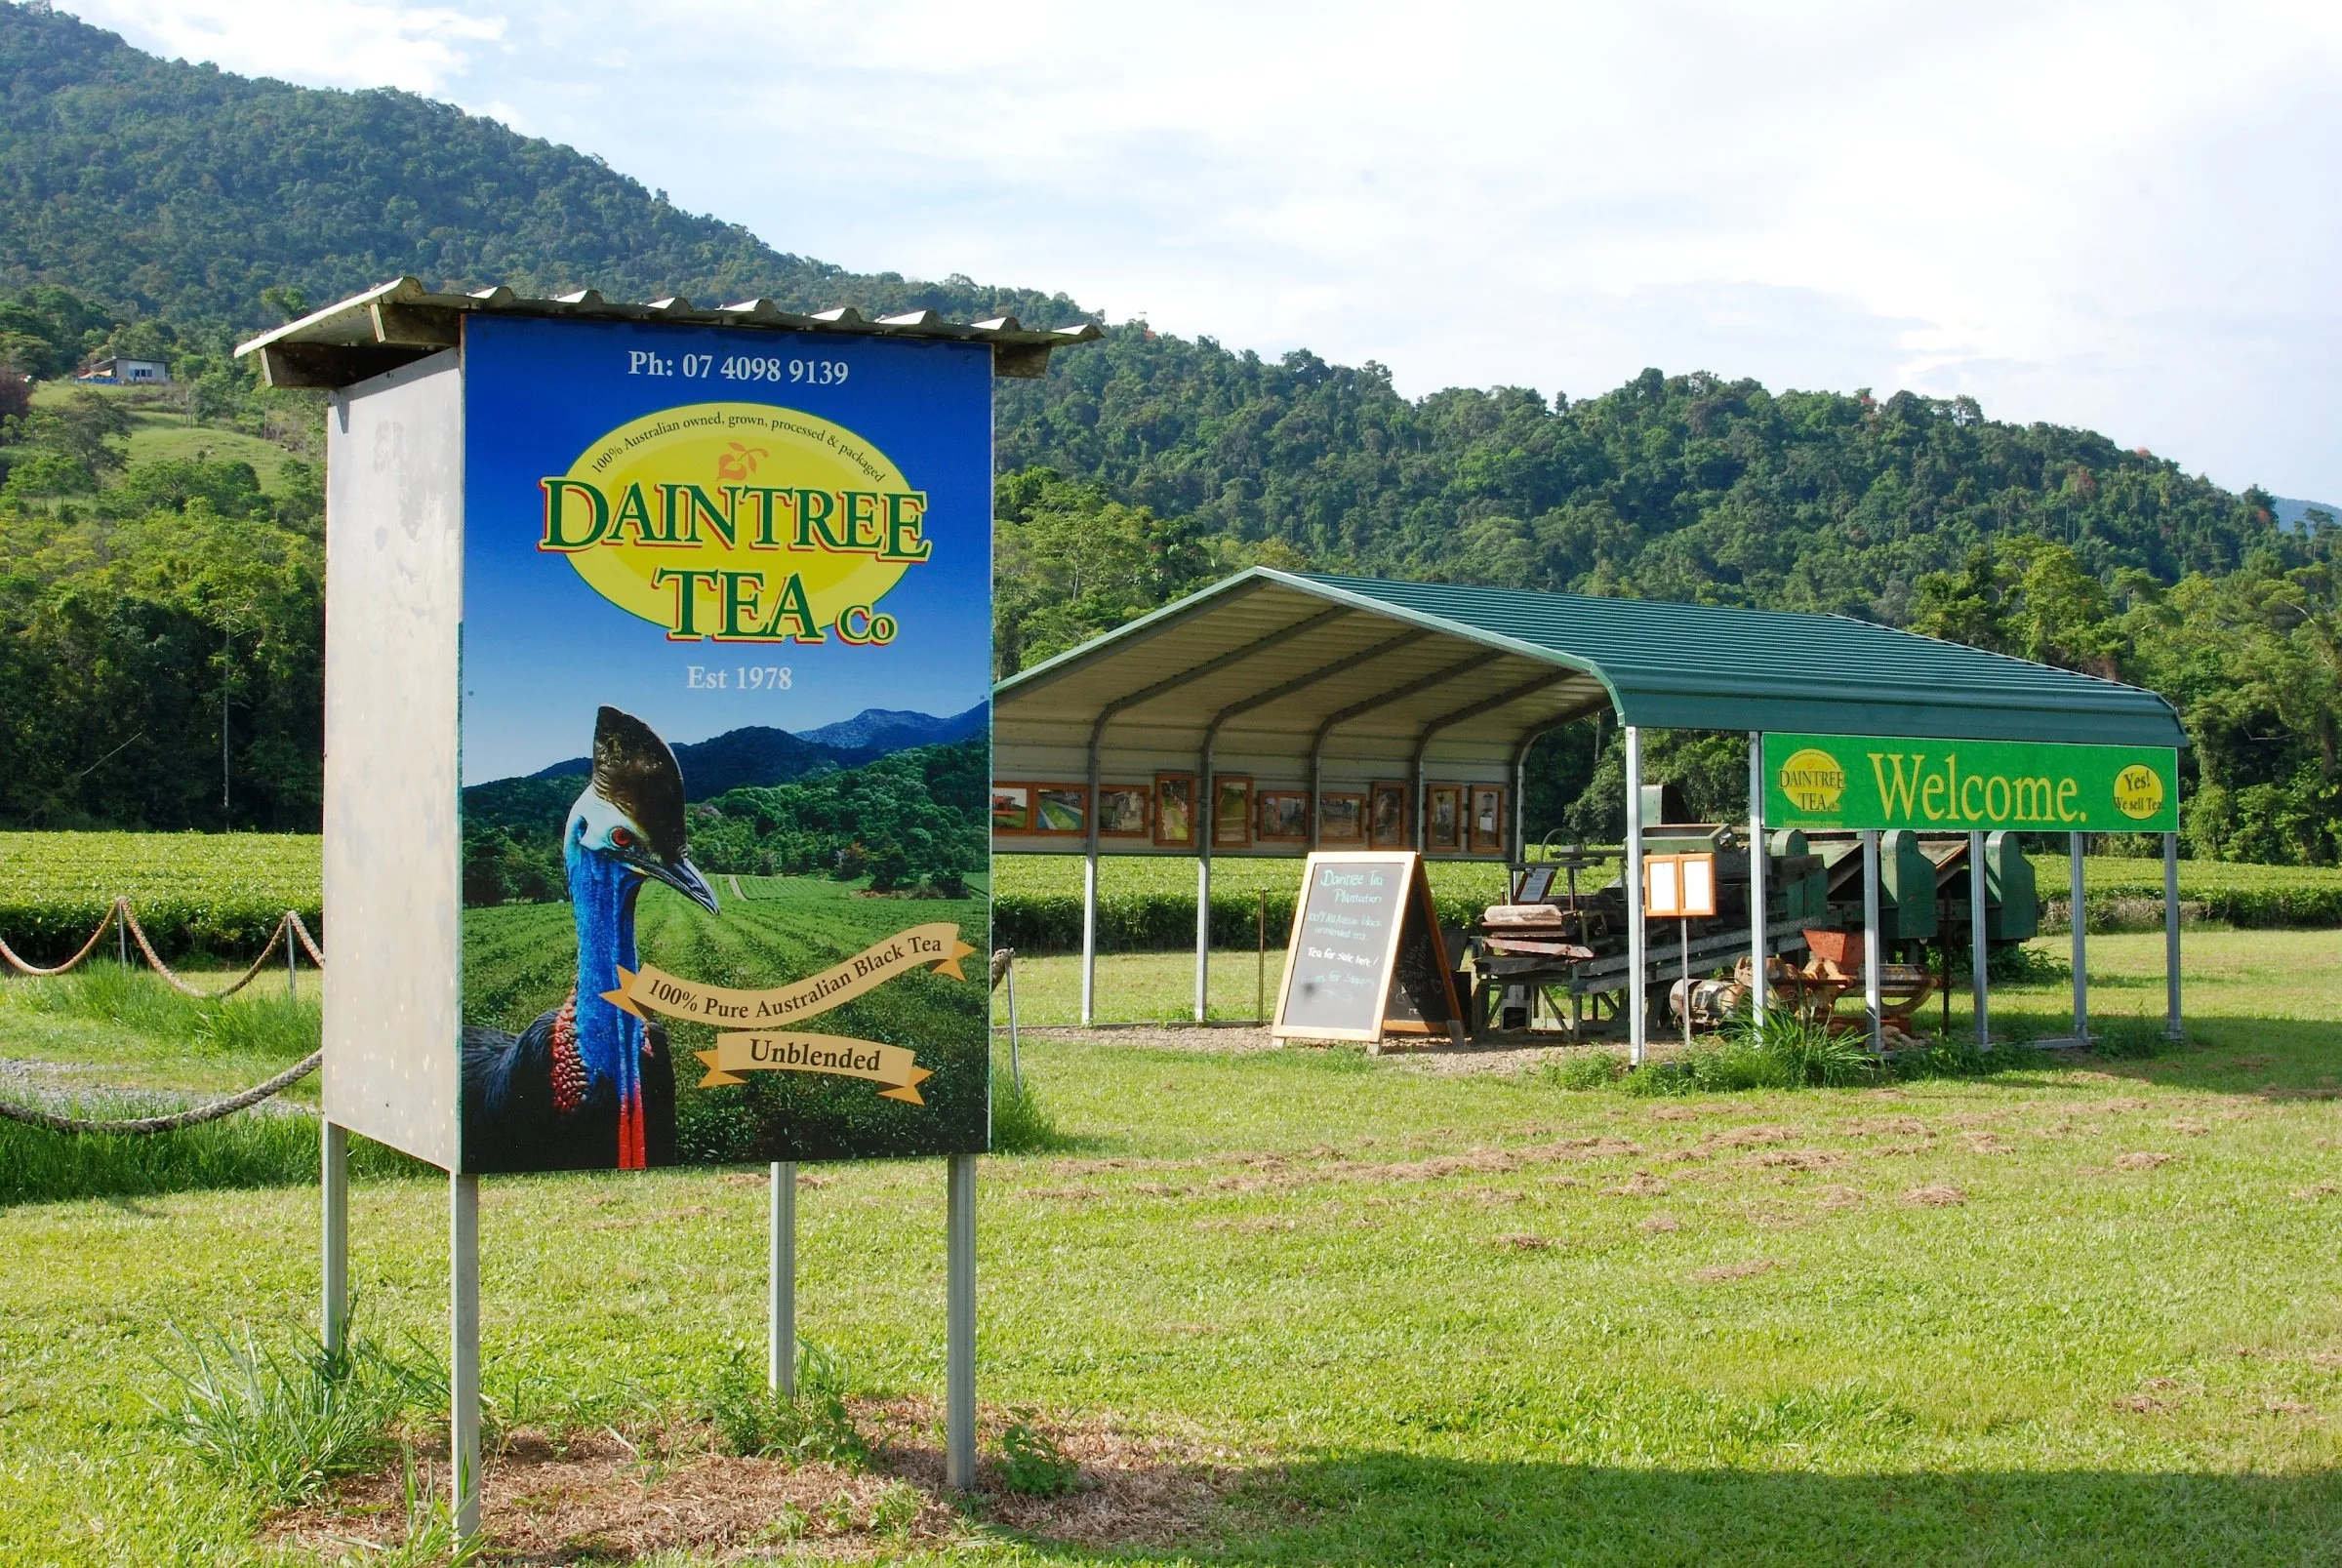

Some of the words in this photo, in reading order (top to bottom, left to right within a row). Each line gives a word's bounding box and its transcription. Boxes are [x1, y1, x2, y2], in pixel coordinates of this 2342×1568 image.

[627, 349, 673, 377] Ph:
[683, 353, 712, 379] 07
[720, 355, 781, 382] 4098
[788, 359, 849, 385] 9139
[591, 446, 623, 474] 100%
[624, 422, 680, 450] Australian
[683, 412, 725, 428] owned,
[728, 414, 768, 428] grown,
[771, 419, 825, 441] processed
[827, 435, 839, 448] &
[838, 441, 886, 483] packaged
[536, 476, 933, 564] DAINTREE
[651, 566, 828, 646] TEA
[834, 604, 898, 646] Co
[687, 665, 727, 690] Est
[736, 665, 792, 691] 1978
[1778, 769, 1845, 790] DAINTREE
[1868, 752, 2087, 824] Welcome.
[2123, 769, 2151, 791] Yes!
[1797, 792, 1827, 812] TEA
[2114, 796, 2127, 810] We
[2129, 797, 2144, 810] sell
[1308, 946, 1322, 958] Tea
[1323, 947, 1337, 960] for
[1337, 952, 1353, 964] sale
[647, 978, 698, 1012] 100%
[702, 996, 749, 1019] Pure
[754, 972, 853, 1018] Australian
[851, 943, 905, 976] Black
[908, 936, 943, 953] Tea
[749, 1038, 882, 1071] Unblended
